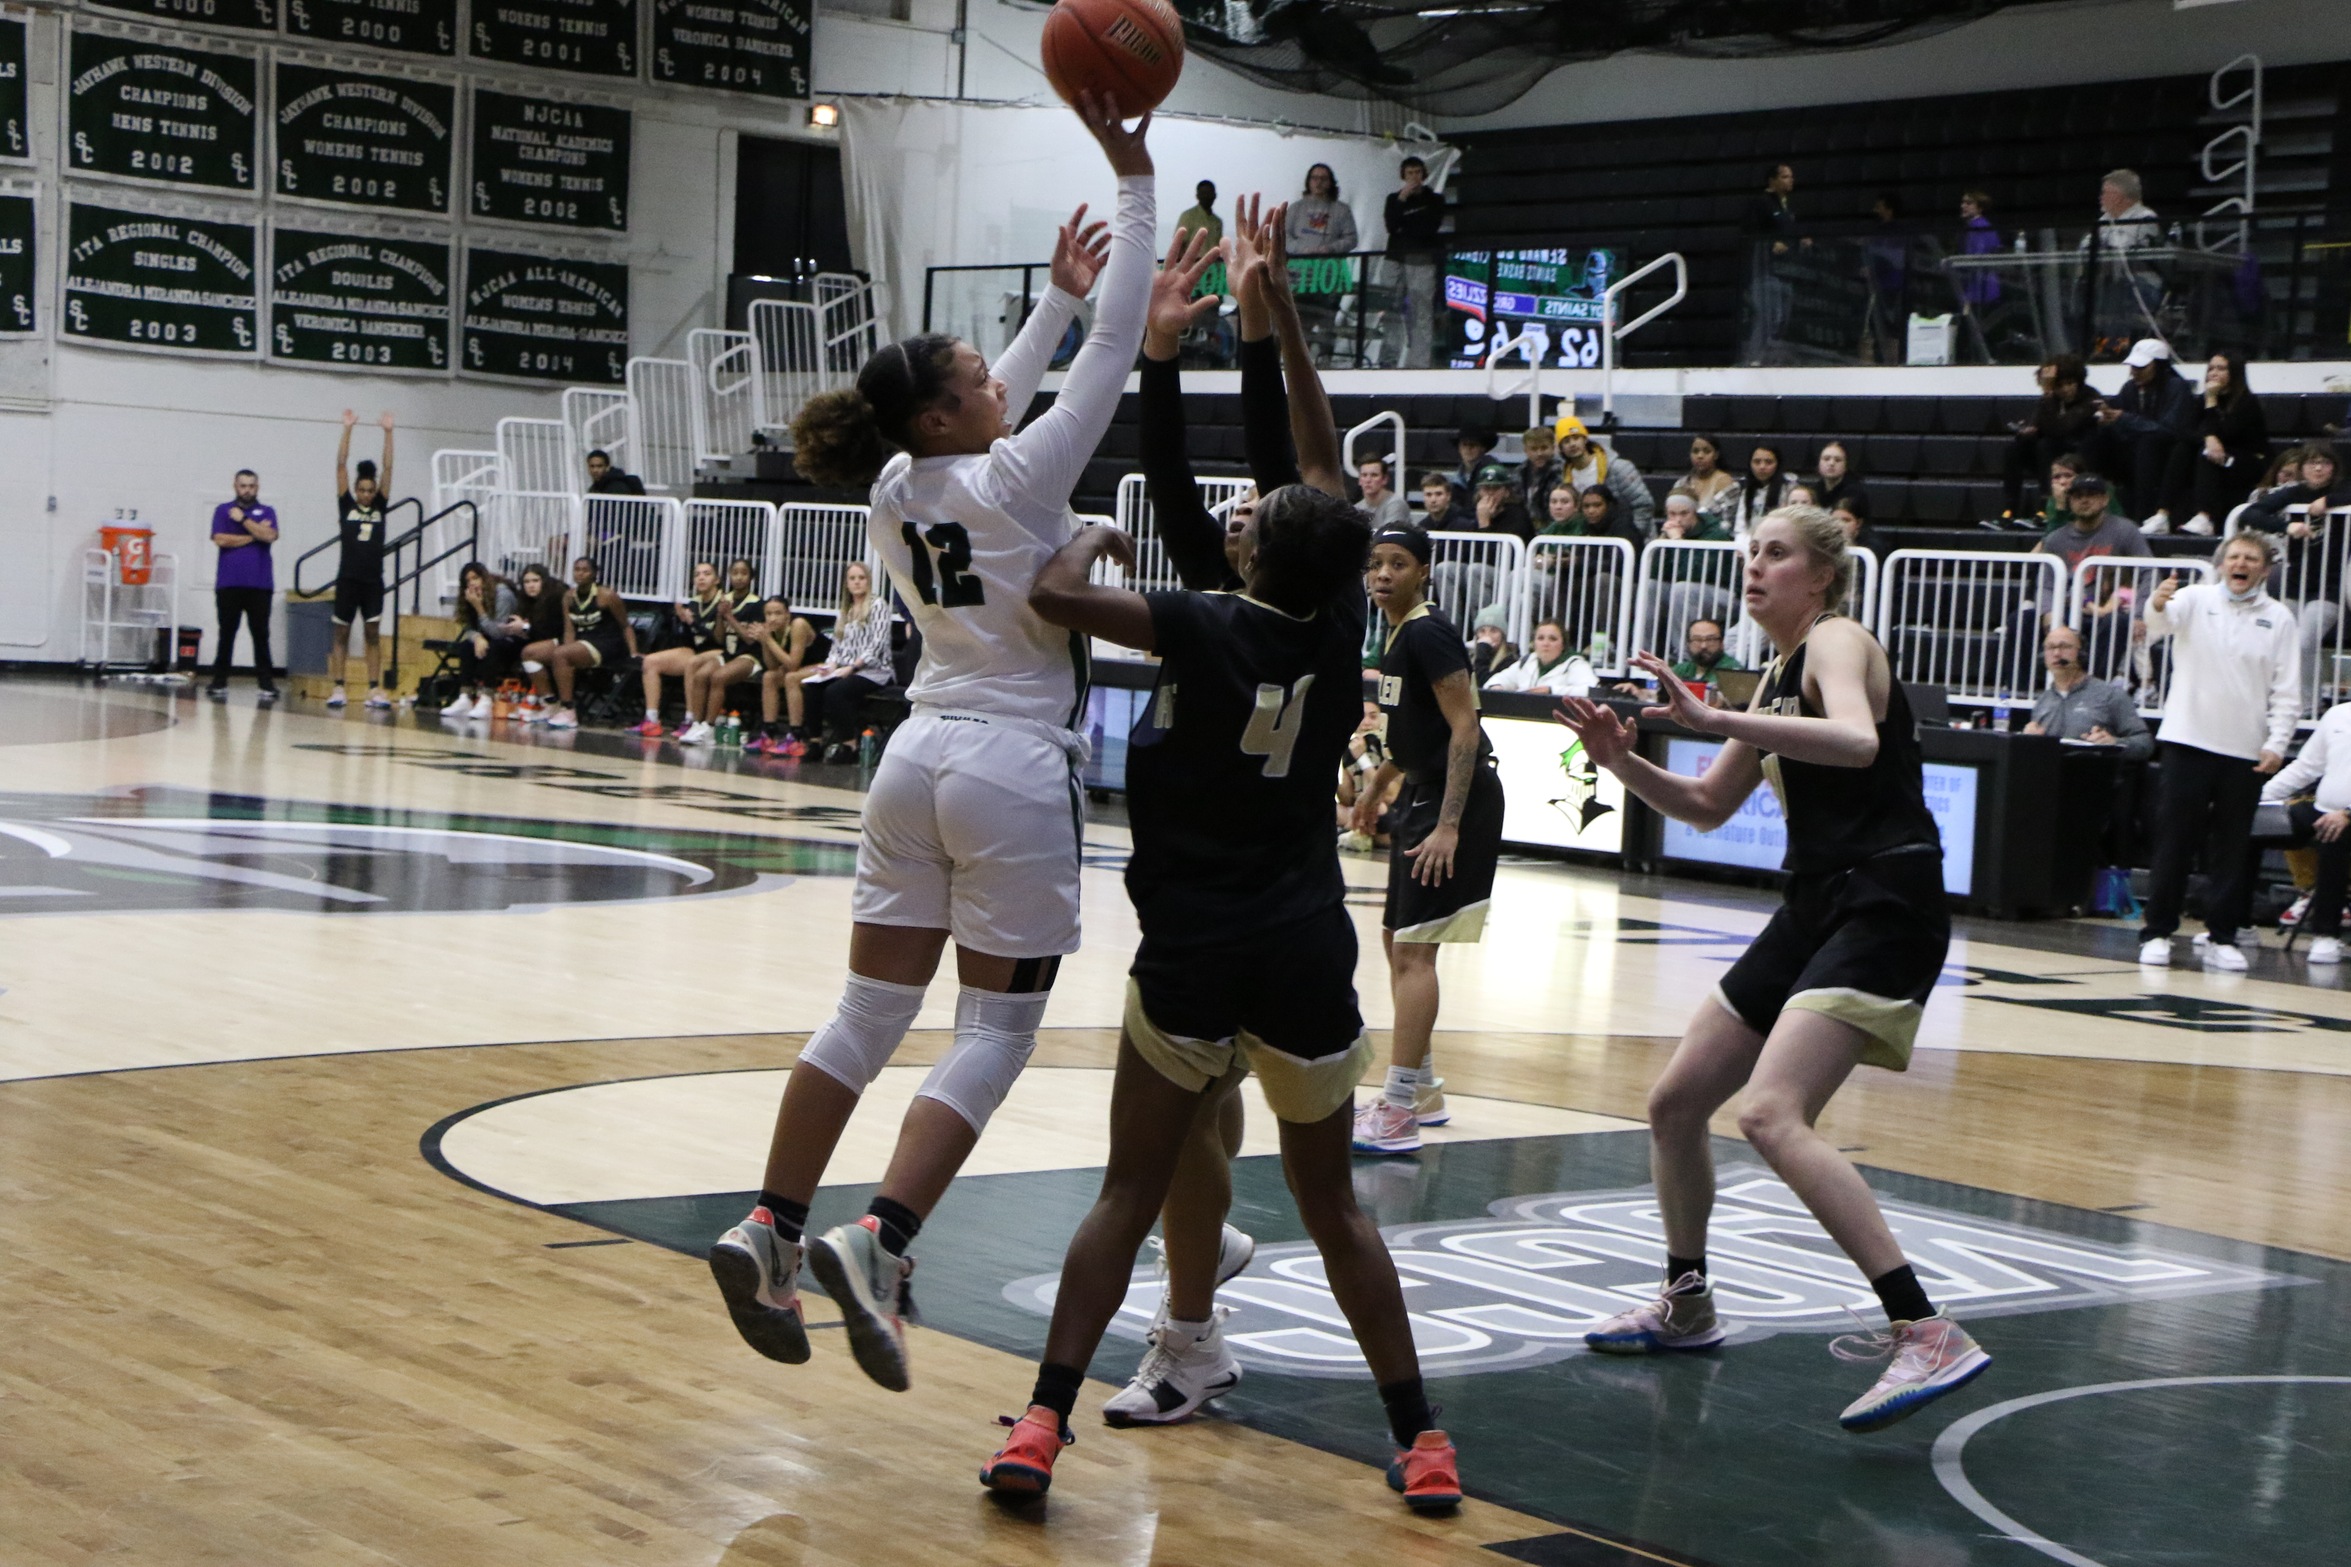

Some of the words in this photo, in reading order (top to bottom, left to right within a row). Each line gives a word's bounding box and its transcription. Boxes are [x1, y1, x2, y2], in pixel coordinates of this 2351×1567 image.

[498, 8, 550, 29] WOMENS
[558, 18, 608, 36] TENNIS
[686, 4, 734, 23] WOMENS
[738, 11, 778, 30] TENNIS
[342, 17, 400, 42] 2000
[672, 28, 730, 48] VERONICA
[523, 38, 581, 62] 2001
[72, 56, 129, 95] JAYHAWK
[132, 54, 197, 78] WESTERN
[200, 68, 253, 116] DIVISION
[704, 62, 762, 86] 2004
[120, 85, 208, 110] CHAMPIONS
[280, 84, 334, 124] JAYHAWK
[336, 82, 398, 104] WESTERN
[400, 96, 446, 140] DIVISION
[524, 105, 583, 128] NJCAA
[112, 112, 152, 132] MENS
[159, 120, 218, 140] TENNIS
[322, 112, 407, 136] CHAMPIONS
[132, 150, 193, 174] 2002
[304, 139, 364, 160] WOMENS
[370, 147, 424, 166] TENNIS
[333, 176, 396, 198] 2002
[500, 168, 553, 187] WOMENS
[560, 174, 604, 192] TENNIS
[524, 198, 577, 219] 2002
[74, 235, 104, 262] ITA
[107, 222, 180, 242] REGIONAL
[187, 230, 251, 280] CHAMPION
[134, 250, 197, 272] SINGLES
[277, 260, 305, 283] ITA
[307, 244, 373, 266] REGIONAL
[332, 271, 394, 290] DOUBLES
[470, 271, 518, 306] NJCAA
[130, 319, 196, 342] 2003
[332, 342, 391, 362] 2003
[128, 538, 144, 554] G
[901, 522, 986, 608] 12
[1240, 674, 1316, 777] 4
